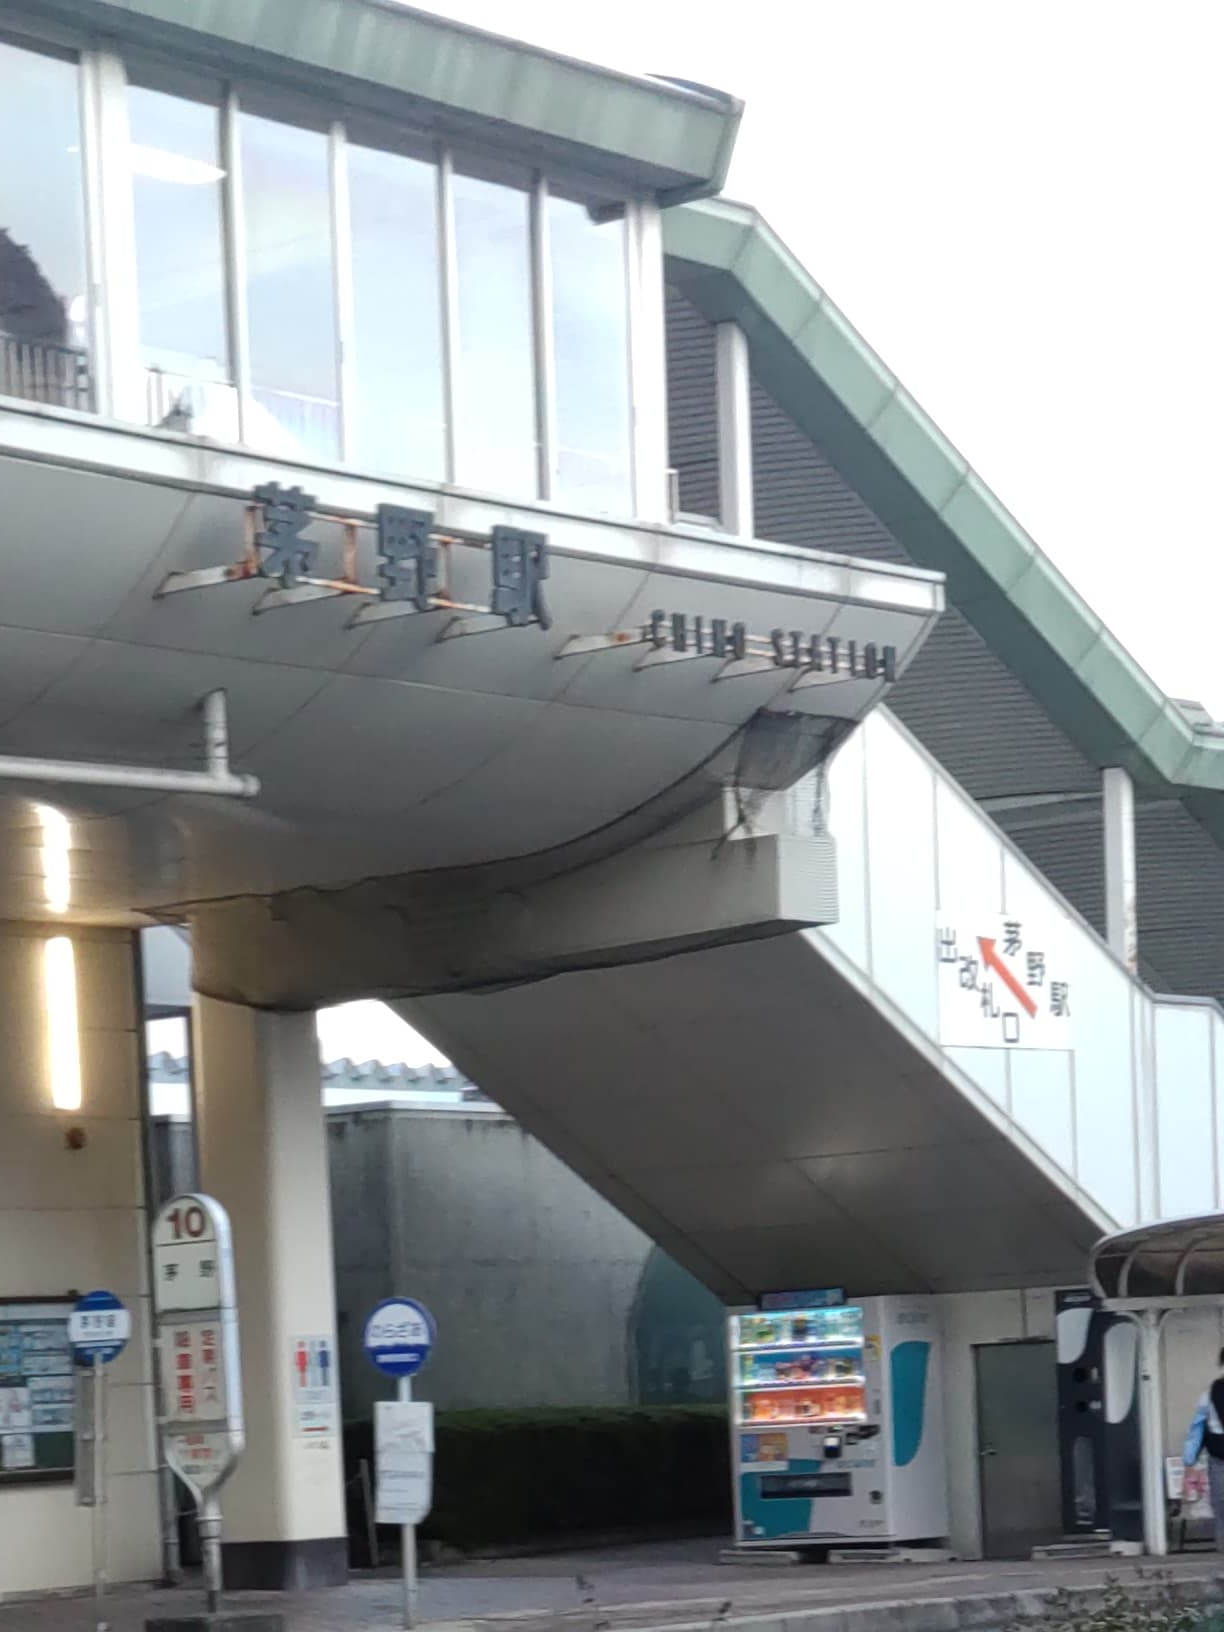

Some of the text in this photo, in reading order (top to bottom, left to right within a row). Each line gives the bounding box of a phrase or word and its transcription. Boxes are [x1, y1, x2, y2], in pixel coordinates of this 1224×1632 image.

[255, 481, 553, 631] 茅野駅
[651, 609, 896, 682] CHINO STATION
[166, 1206, 205, 1239] 10
